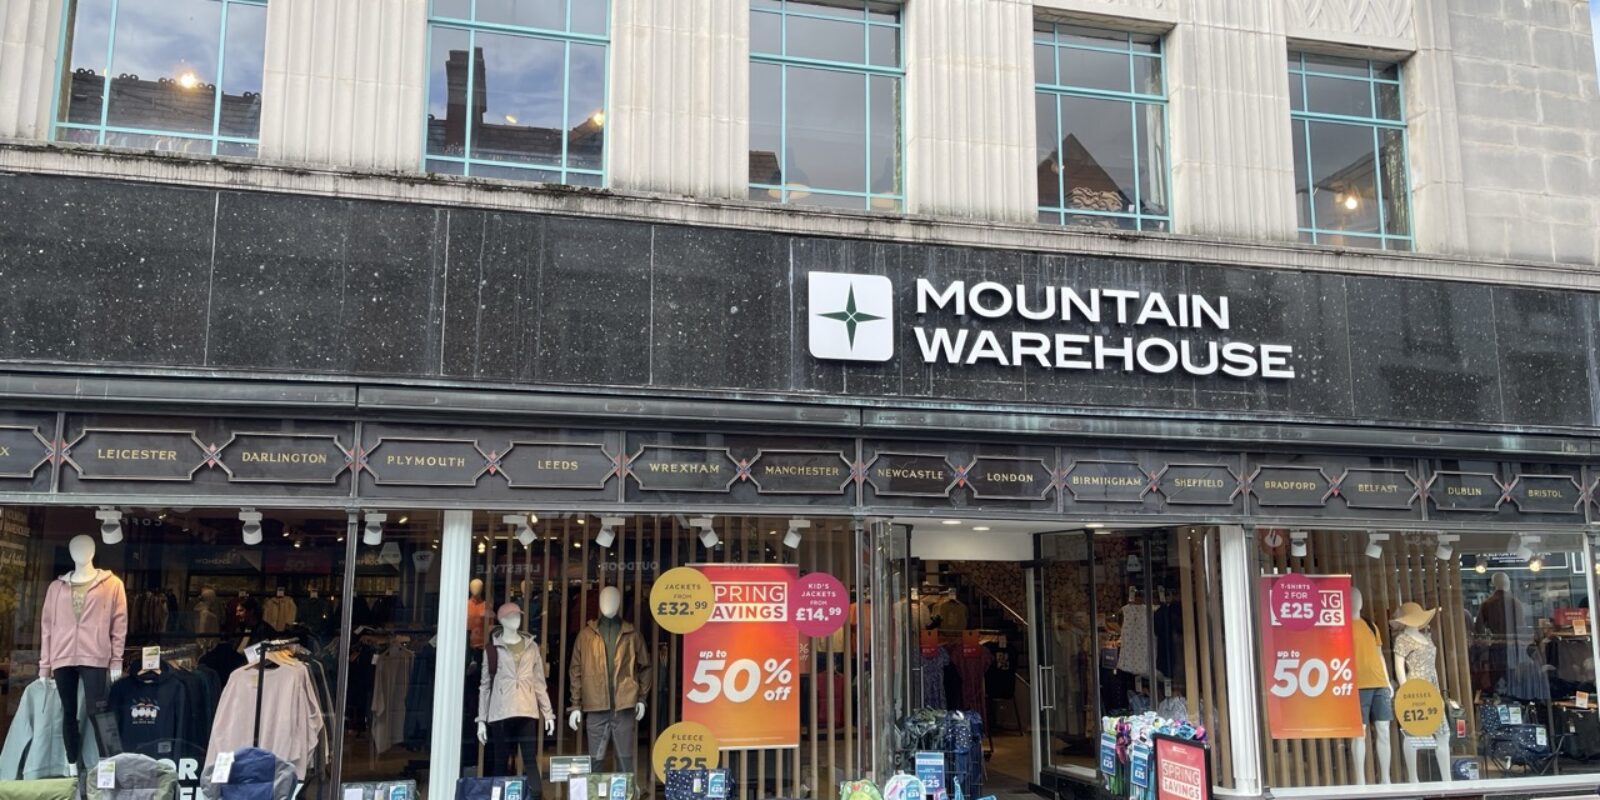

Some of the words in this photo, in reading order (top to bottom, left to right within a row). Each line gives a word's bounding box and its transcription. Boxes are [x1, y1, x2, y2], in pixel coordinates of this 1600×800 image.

[916, 278, 1230, 330] MOUNTAIN
[914, 326, 1296, 379] WAREHOUSE
[98, 449, 177, 461] LEICESTER
[242, 451, 327, 464] DARLINGTON
[387, 454, 466, 468] PLYMOUTH
[537, 460, 579, 471] LEEDS
[649, 463, 720, 474] WREXHAM
[765, 465, 840, 477] MANCHESTER
[877, 468, 944, 480] NEWCASTLE
[986, 472, 1034, 483] LONDON
[1072, 475, 1142, 487] BIRMINGHAM
[1174, 478, 1224, 488] SHEFFIELD
[1264, 480, 1316, 491] BRADFORD
[1358, 483, 1399, 493] BELFAST
[1448, 486, 1482, 496] DUBLIN
[1528, 489, 1563, 498] BRISTOL
[664, 583, 702, 591] JACKETS
[713, 585, 785, 602] PRING
[1284, 591, 1290, 600] 2
[1290, 591, 1308, 600] FOR
[657, 601, 708, 615] £32.99
[711, 605, 784, 619] AVINGS
[796, 607, 842, 621] £14.99
[1280, 602, 1314, 619] £25
[699, 650, 714, 660] up
[716, 649, 727, 659] to
[1277, 650, 1289, 660] up
[1290, 648, 1300, 658] to
[763, 686, 792, 701] off
[1332, 683, 1354, 697] off
[671, 733, 704, 742] FLEECE
[671, 743, 678, 752] 2
[680, 743, 702, 753] FOR
[664, 756, 707, 771] £25
[1161, 761, 1201, 786] SPRING
[1164, 778, 1201, 800] SAVINGS
